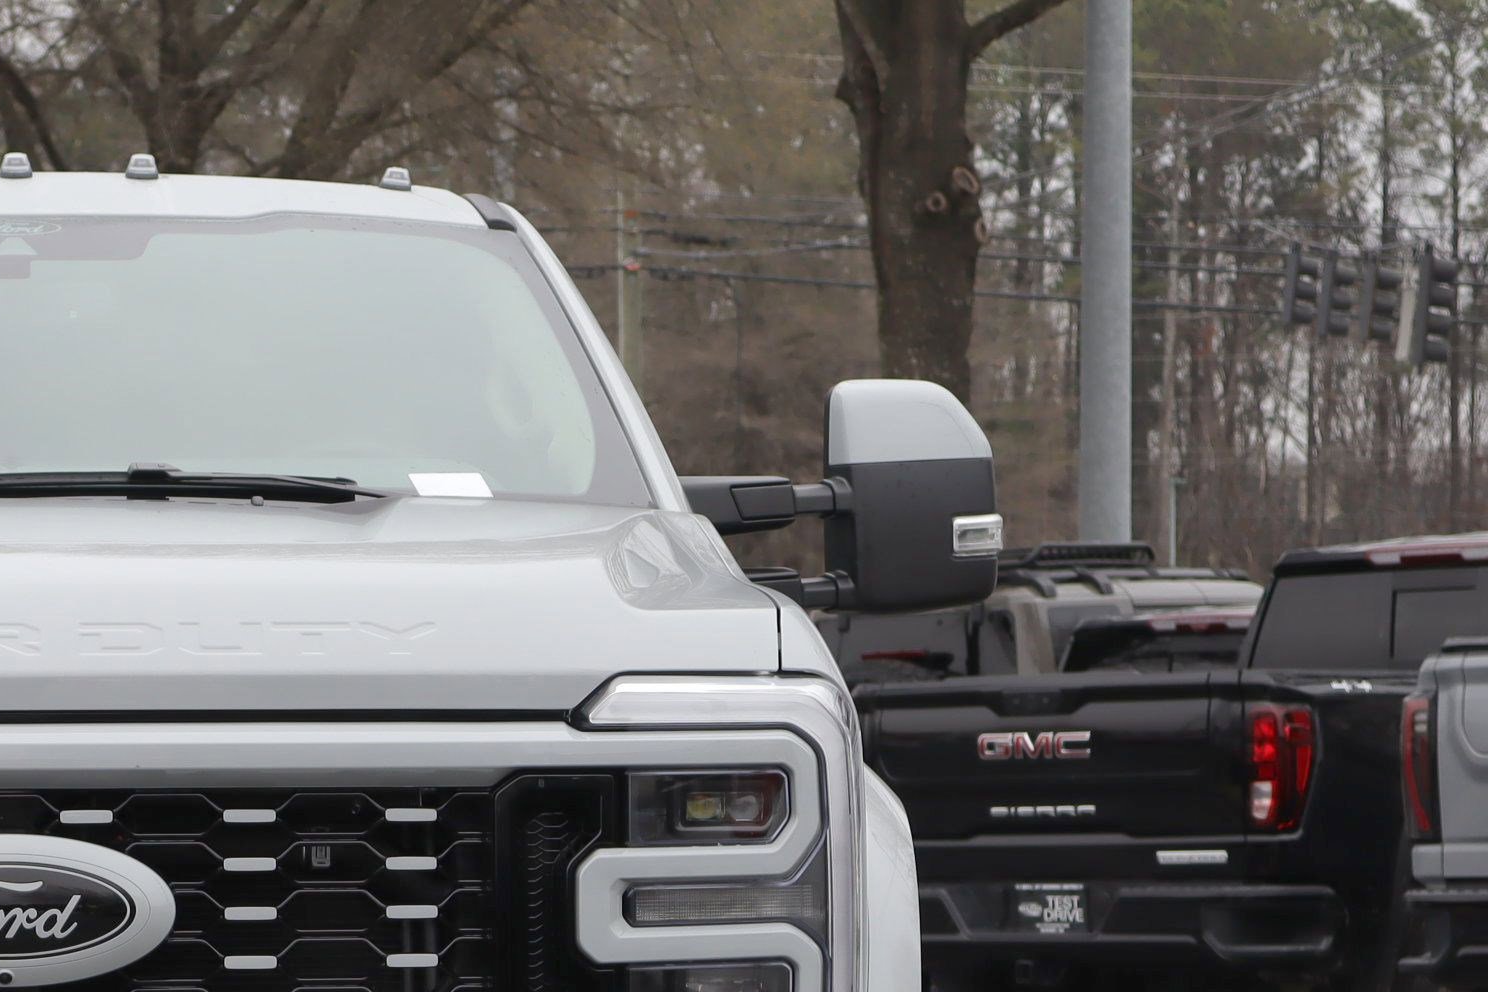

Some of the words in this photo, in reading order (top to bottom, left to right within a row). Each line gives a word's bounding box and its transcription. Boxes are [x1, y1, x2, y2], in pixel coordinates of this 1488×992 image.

[77, 619, 439, 656] DUTY
[976, 730, 1091, 760] GMC
[1045, 895, 1080, 910] TEST
[1043, 907, 1085, 923] DRIVE
